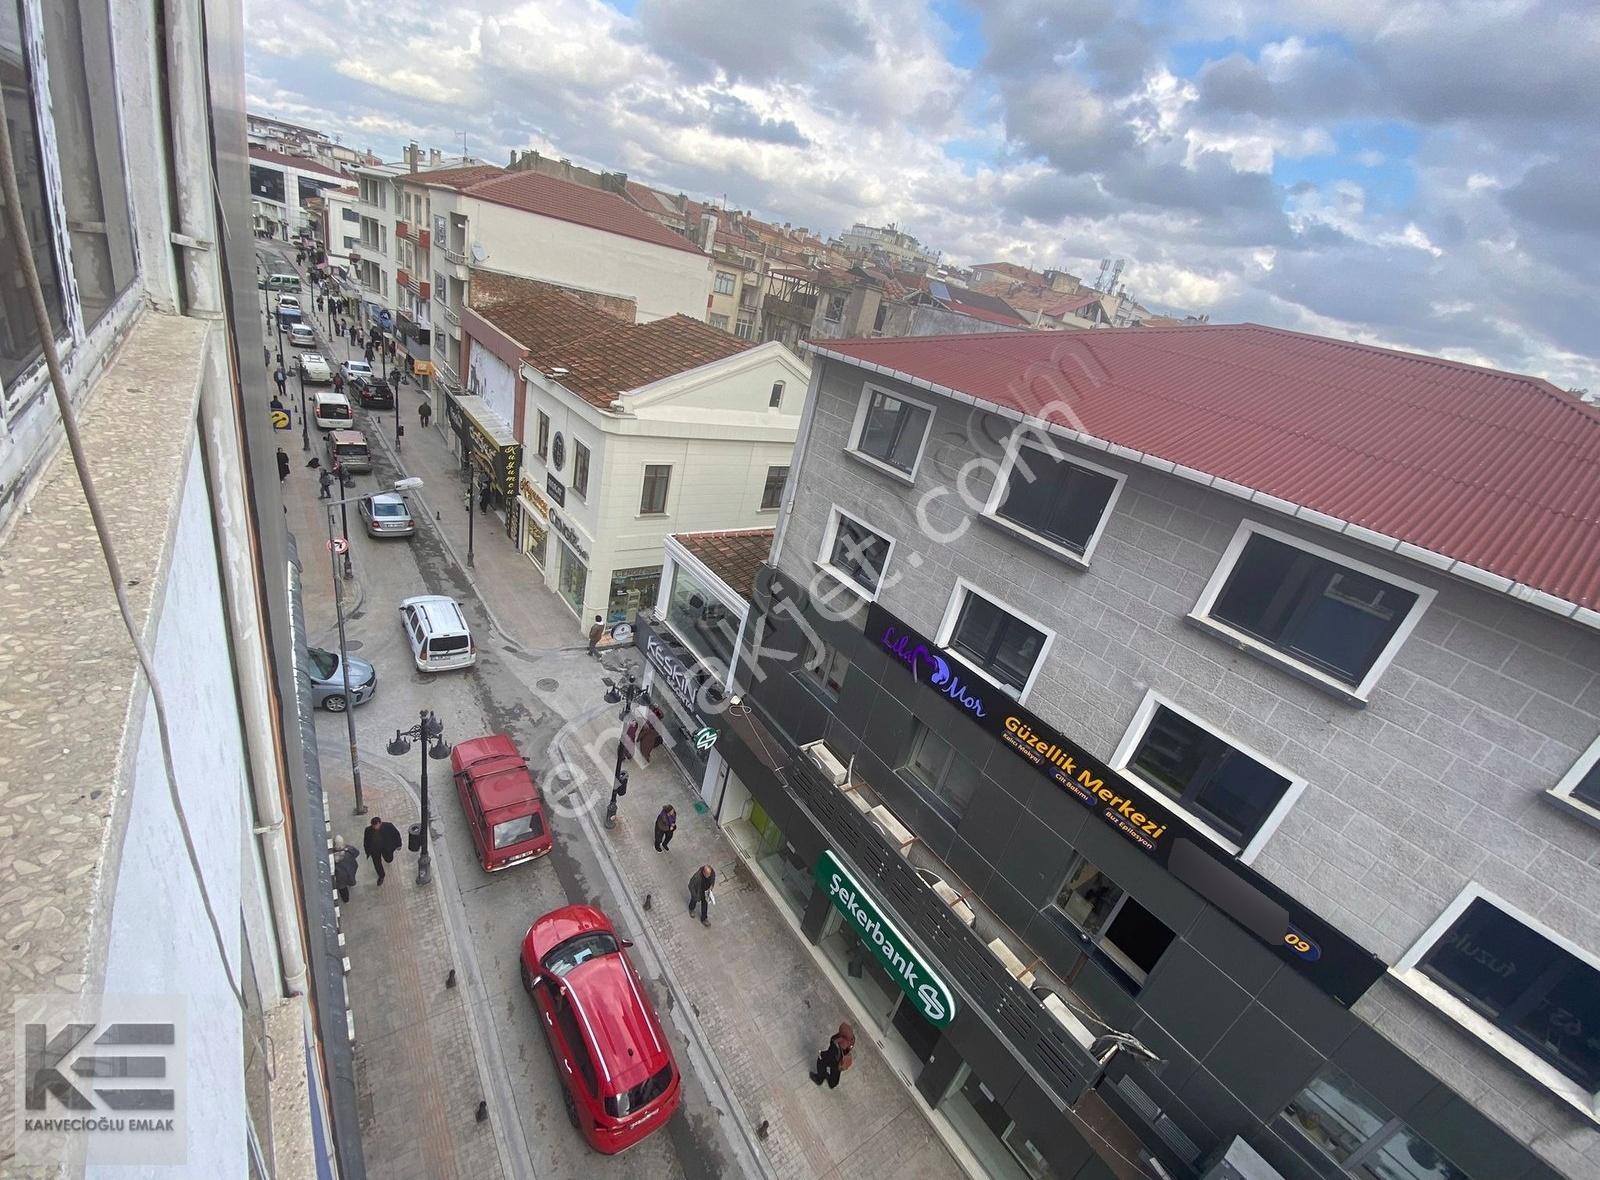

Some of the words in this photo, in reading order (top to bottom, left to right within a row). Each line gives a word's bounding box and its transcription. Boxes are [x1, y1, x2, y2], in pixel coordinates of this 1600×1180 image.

[505, 446, 517, 495] Kuyumcu
[942, 677, 986, 717] Mor
[1018, 743, 1042, 764] Makyaj
[1004, 715, 1077, 776] Güzellik
[1077, 769, 1168, 840] Merkezi
[1104, 810, 1119, 823] Buz
[1118, 821, 1153, 850] Epilasyon
[828, 872, 919, 989] Şekerbank
[1283, 932, 1311, 955] 09
